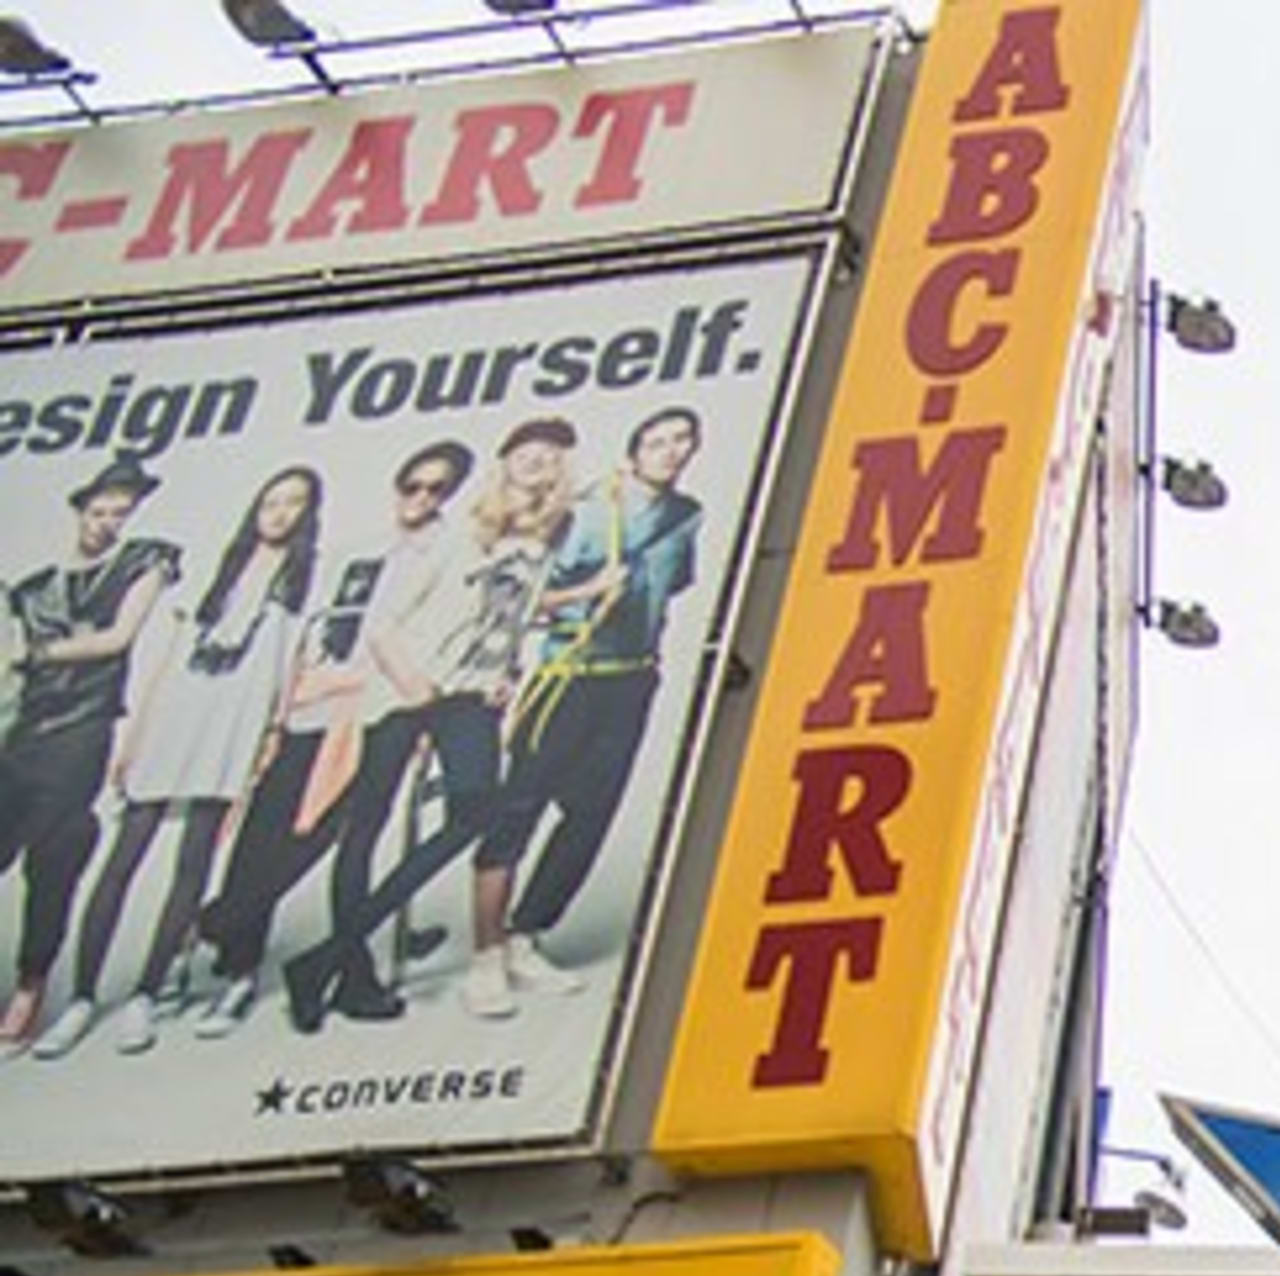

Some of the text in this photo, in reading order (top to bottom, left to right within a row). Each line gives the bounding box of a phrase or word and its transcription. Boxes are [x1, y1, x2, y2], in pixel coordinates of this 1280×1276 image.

[303, 299, 762, 428] Yourself.
[743, 5, 1071, 1090] ABC-MART
[295, 1067, 525, 1115] CONVERSE
